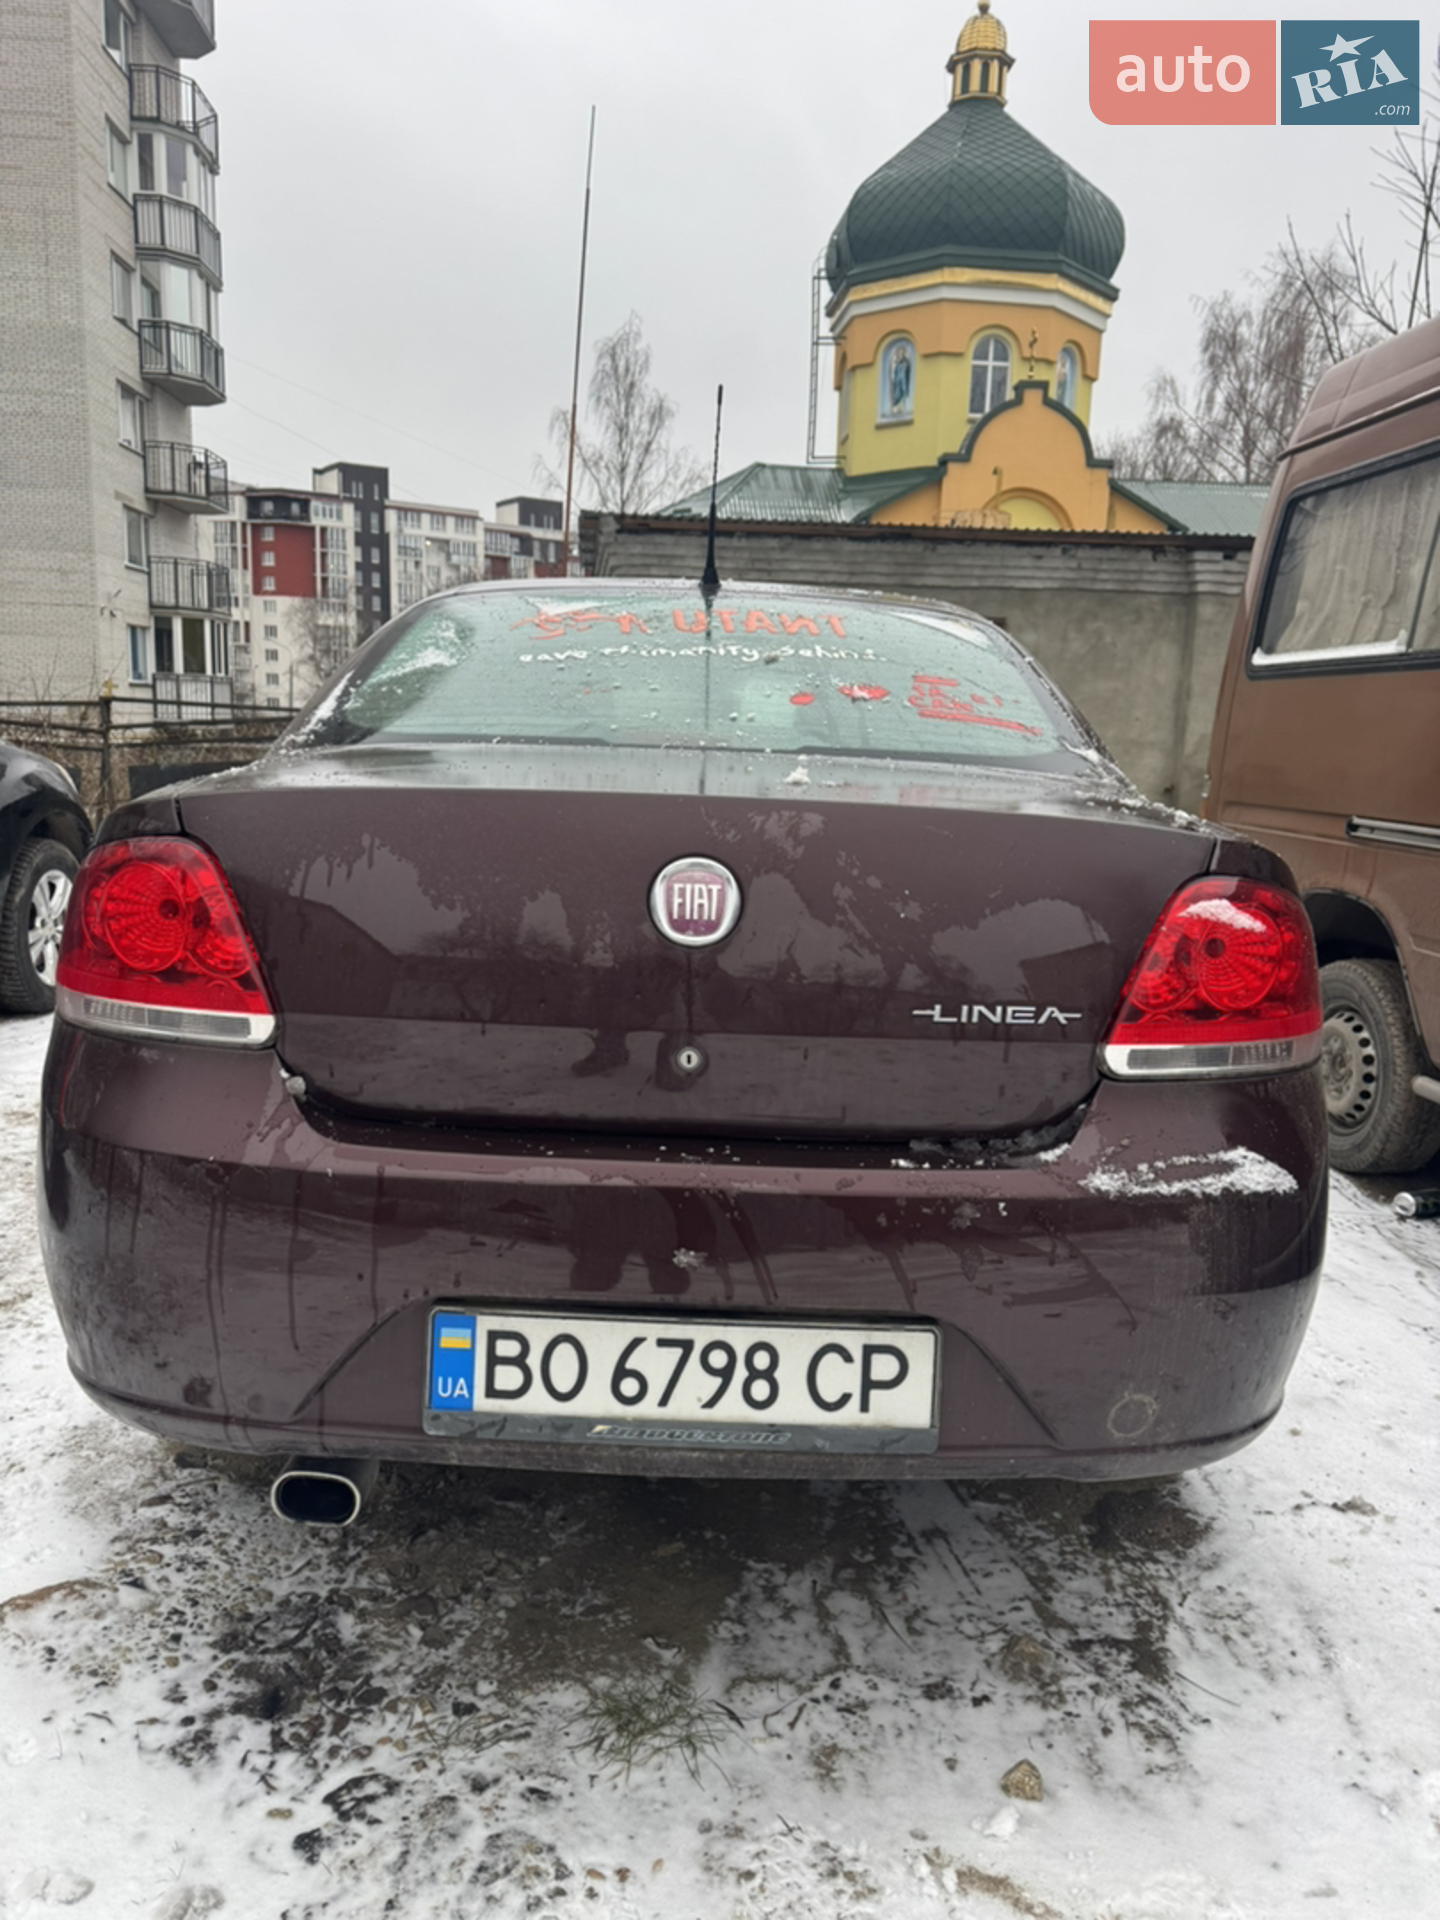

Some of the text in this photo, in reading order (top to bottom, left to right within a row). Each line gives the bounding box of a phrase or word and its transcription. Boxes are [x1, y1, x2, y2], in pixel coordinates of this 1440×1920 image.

[672, 883, 722, 922] FIAT
[912, 1003, 1083, 1025] LINEA
[484, 1329, 909, 1414] BO 6798 CP
[437, 1376, 470, 1399] UA
